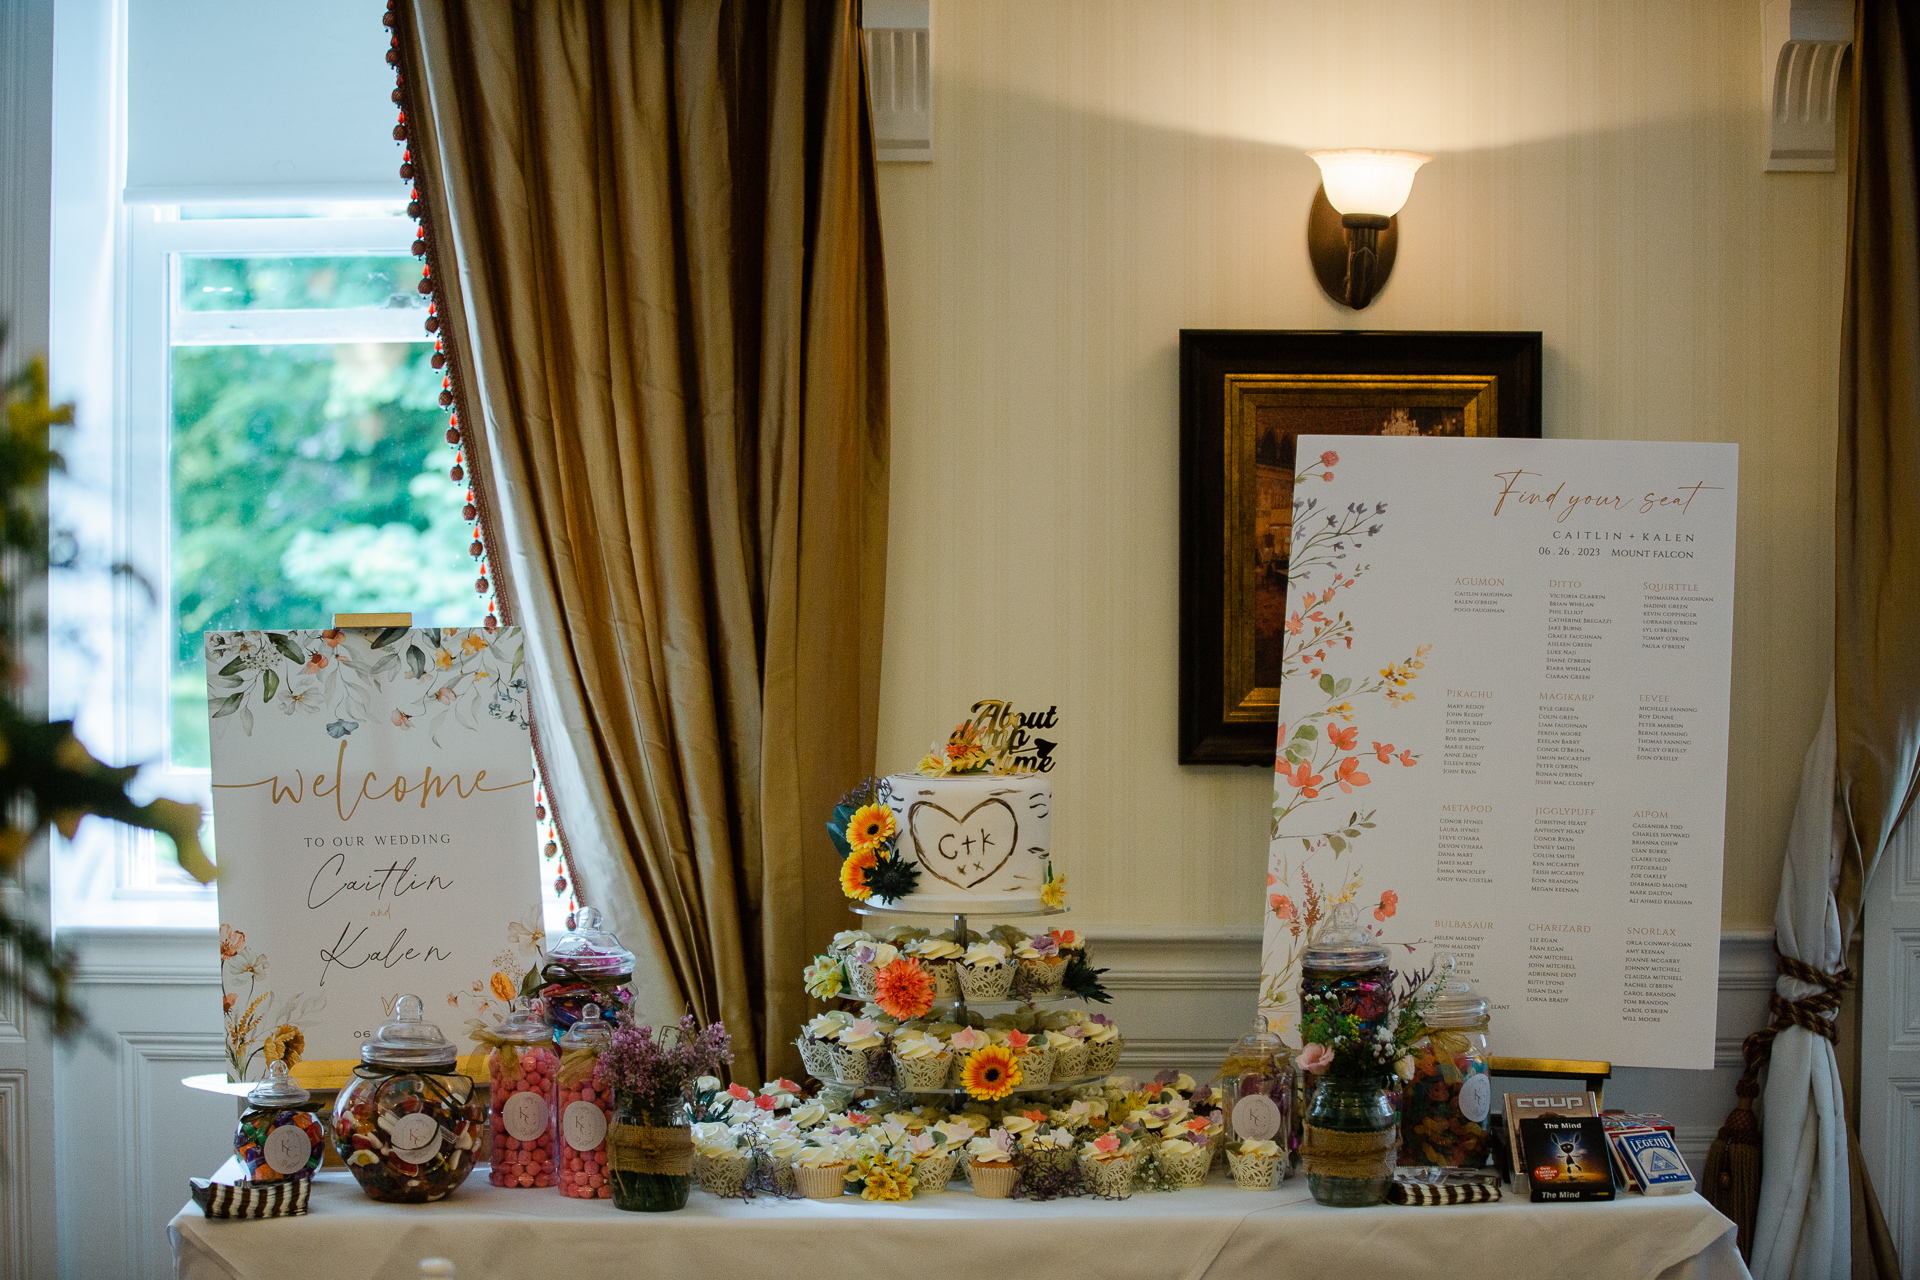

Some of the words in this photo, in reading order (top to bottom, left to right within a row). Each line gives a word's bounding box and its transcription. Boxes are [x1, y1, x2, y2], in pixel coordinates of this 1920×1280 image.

[1494, 469, 1565, 516] Find
[1556, 493, 1633, 524] your
[1639, 480, 1724, 515] seat
[1553, 531, 1622, 540] CAITLIN
[1642, 533, 1695, 542] KALEN
[1611, 548, 1651, 558] MOUNT
[1653, 549, 1694, 559] FALCON
[1455, 577, 1505, 587] AGUMON
[1549, 580, 1582, 589] DITTO
[1643, 582, 1699, 592] SQUIRTTLE
[1447, 690, 1493, 699] PIKACHU
[1539, 693, 1595, 702] MAGIKARP
[1639, 694, 1670, 703] EEVEE
[970, 700, 1059, 729] About
[213, 739, 533, 821] welcome
[1442, 804, 1493, 813] METAPOD
[1535, 807, 1596, 816] JIGGLYPUFF
[1634, 810, 1669, 819] AIPOM
[304, 837, 324, 848] TO
[333, 836, 365, 847] OUR
[375, 833, 451, 846] WEDDING
[307, 853, 454, 909] Caitlin
[370, 903, 391, 920] and
[1434, 920, 1494, 930] BULBASAUR
[1528, 924, 1592, 933] CHARIZARD
[1627, 927, 1676, 936] SNORLAX
[320, 921, 452, 986] Kalen
[353, 1031, 371, 1039] 06
[1516, 1097, 1584, 1110] coup
[1630, 1137, 1671, 1153] LEGEND
[1542, 1191, 1557, 1199] The
